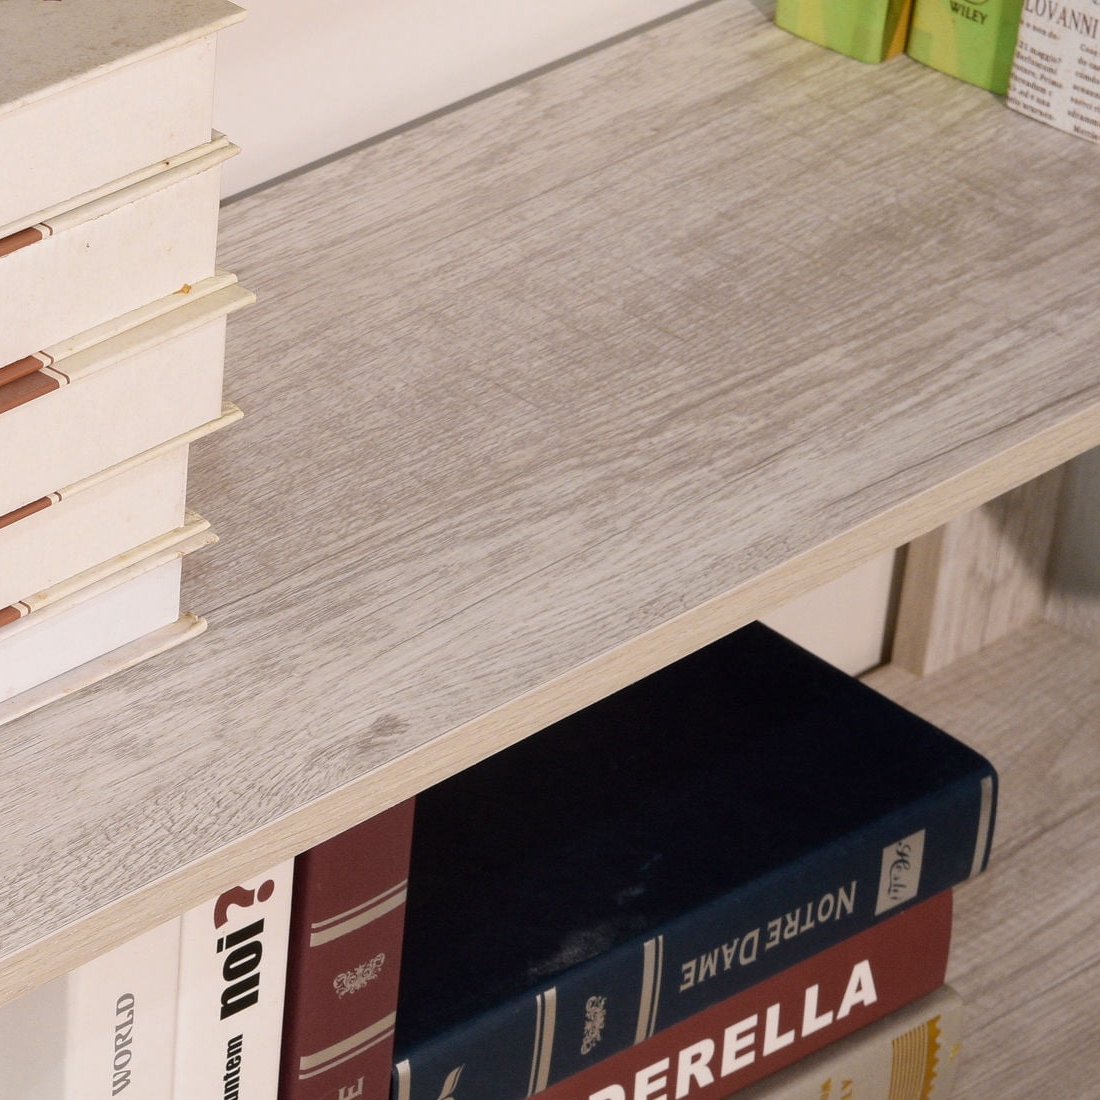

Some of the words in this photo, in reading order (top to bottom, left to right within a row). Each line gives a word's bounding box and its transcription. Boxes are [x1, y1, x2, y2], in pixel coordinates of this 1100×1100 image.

[950, 2, 988, 25] WILEY
[764, 880, 858, 952] NOTRE
[679, 928, 761, 992] DAME
[112, 992, 135, 1097] WORLD
